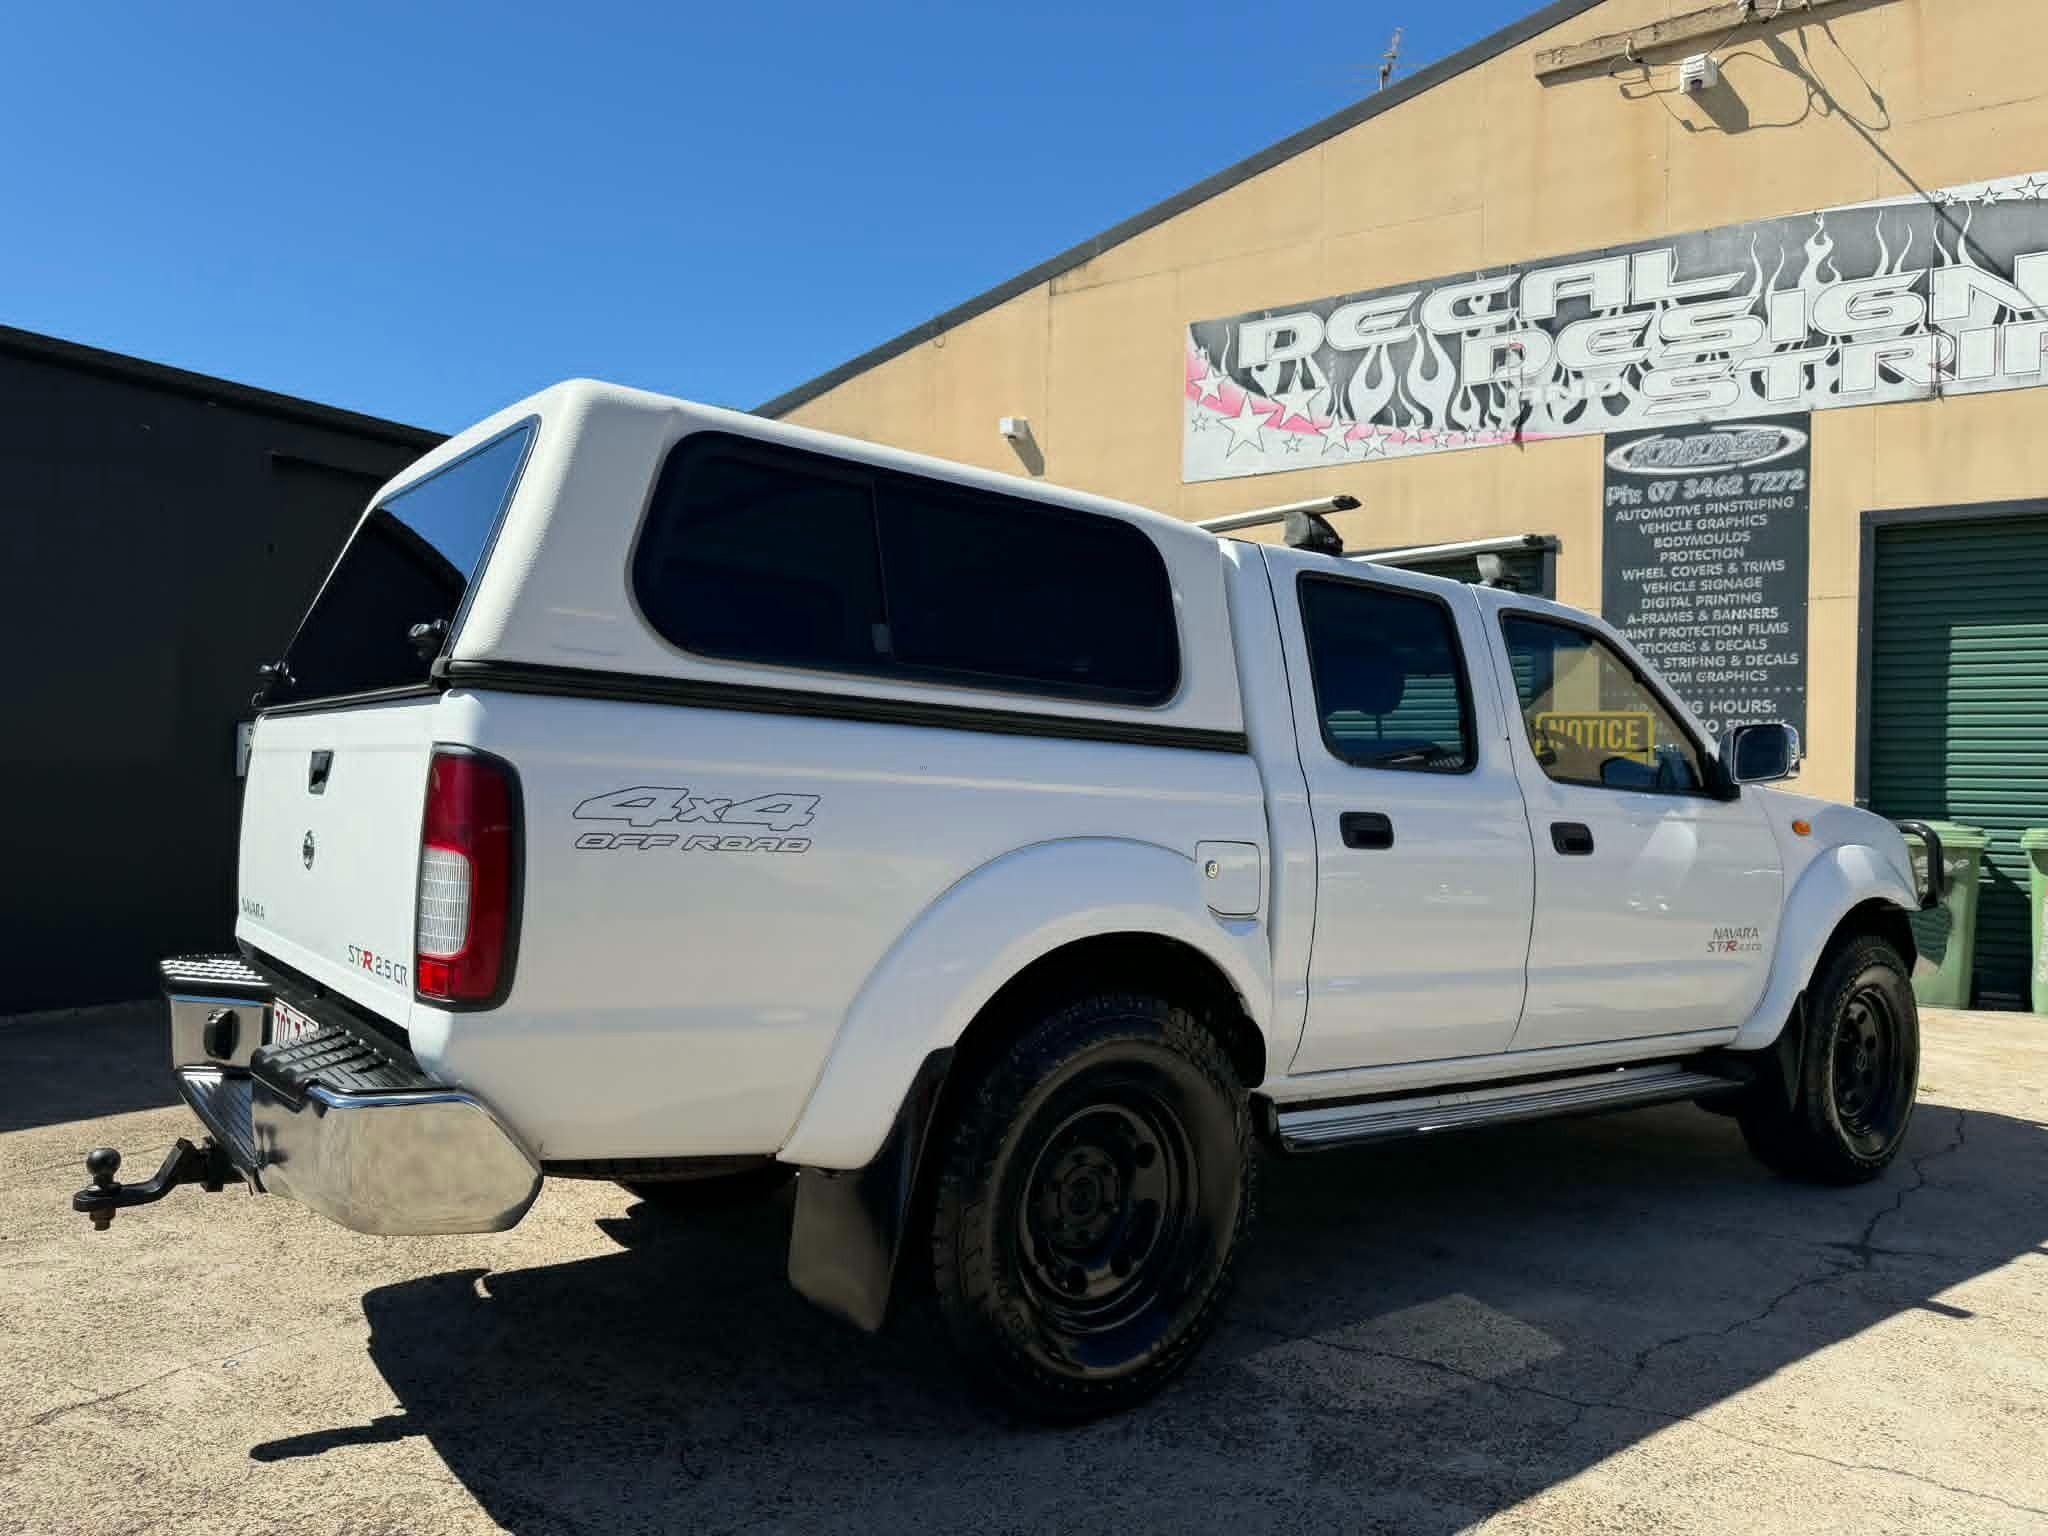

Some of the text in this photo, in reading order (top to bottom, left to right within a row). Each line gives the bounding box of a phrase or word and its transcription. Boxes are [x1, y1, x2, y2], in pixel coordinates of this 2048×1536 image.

[1238, 248, 1746, 368] DECAL
[1461, 250, 2048, 386] DESIGN
[1648, 481, 1679, 502] 07
[1616, 496, 1795, 521] AUTOMOTIVE PINSTRIPING
[1640, 514, 1768, 535] VEHICLE GRAPHICS
[1654, 531, 1751, 548] BODYMOULDS
[1660, 546, 1745, 563] PROTECTION
[1621, 560, 1785, 581] WHEEL COVERS & TRIMS
[1642, 576, 1763, 594] VEHICLE SIGNAGE
[1641, 592, 1762, 610] DIGITAL PRINTING
[1626, 607, 1779, 625] A-FRAMES & BANNERS
[1659, 624, 1744, 639] PROTECTION
[1748, 622, 1790, 636] FILMS
[1700, 641, 1711, 653] &
[1715, 639, 1768, 651] DECALS
[1663, 655, 1726, 669] STRIPING
[1730, 655, 1741, 667] &
[1745, 653, 1800, 666] DECALS
[1696, 670, 1768, 683] GRAPHICS
[1710, 699, 1778, 714] HOURS:
[1551, 719, 1640, 750] NOTICE
[1702, 719, 1719, 733] O
[572, 786, 821, 831] 4x4
[575, 833, 812, 852] OFF ROAD
[1713, 928, 1760, 940] NAVARA
